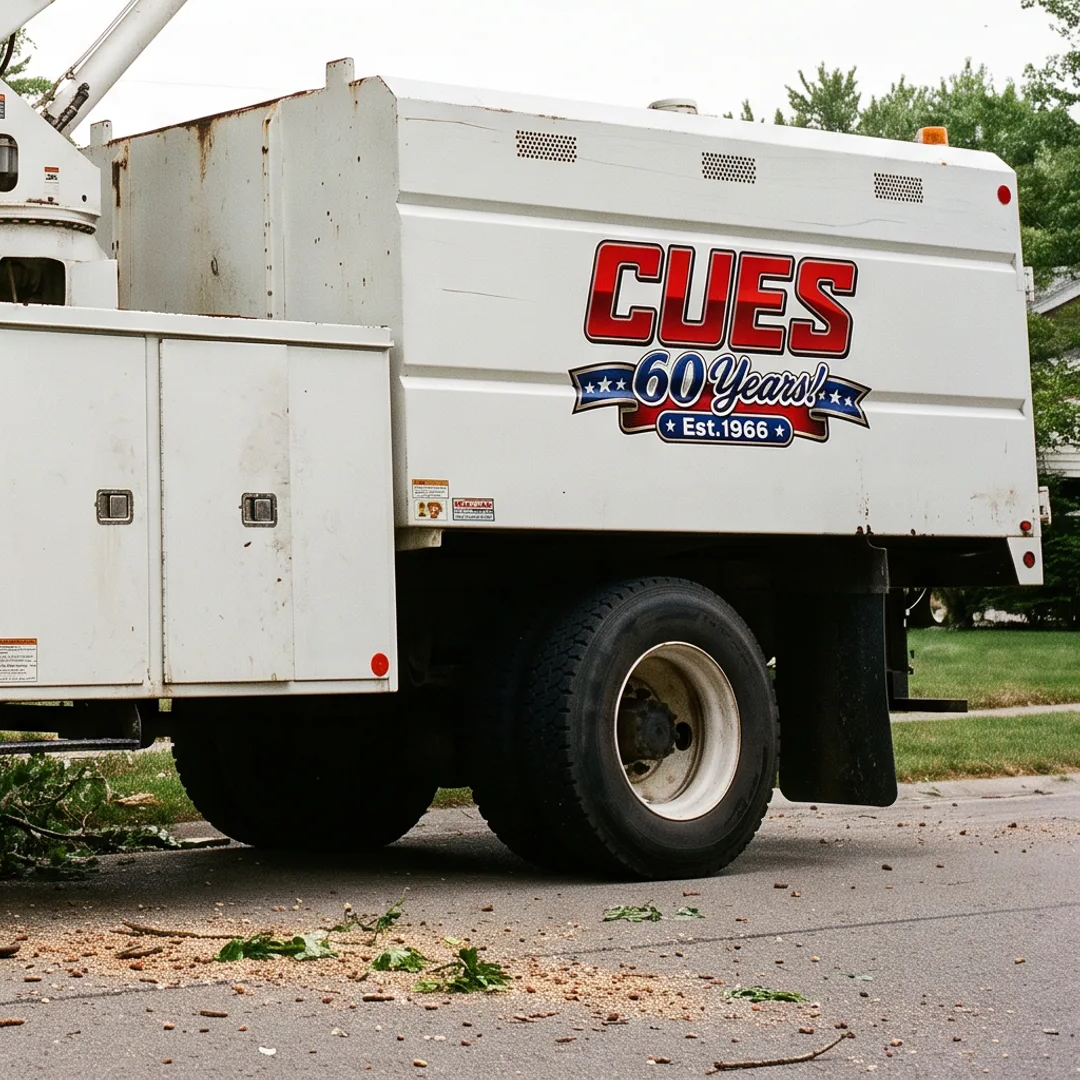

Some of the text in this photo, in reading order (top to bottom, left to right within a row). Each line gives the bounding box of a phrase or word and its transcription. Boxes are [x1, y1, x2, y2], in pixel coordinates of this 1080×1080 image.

[584, 239, 858, 359] CUES
[632, 350, 829, 416] 60 Years!
